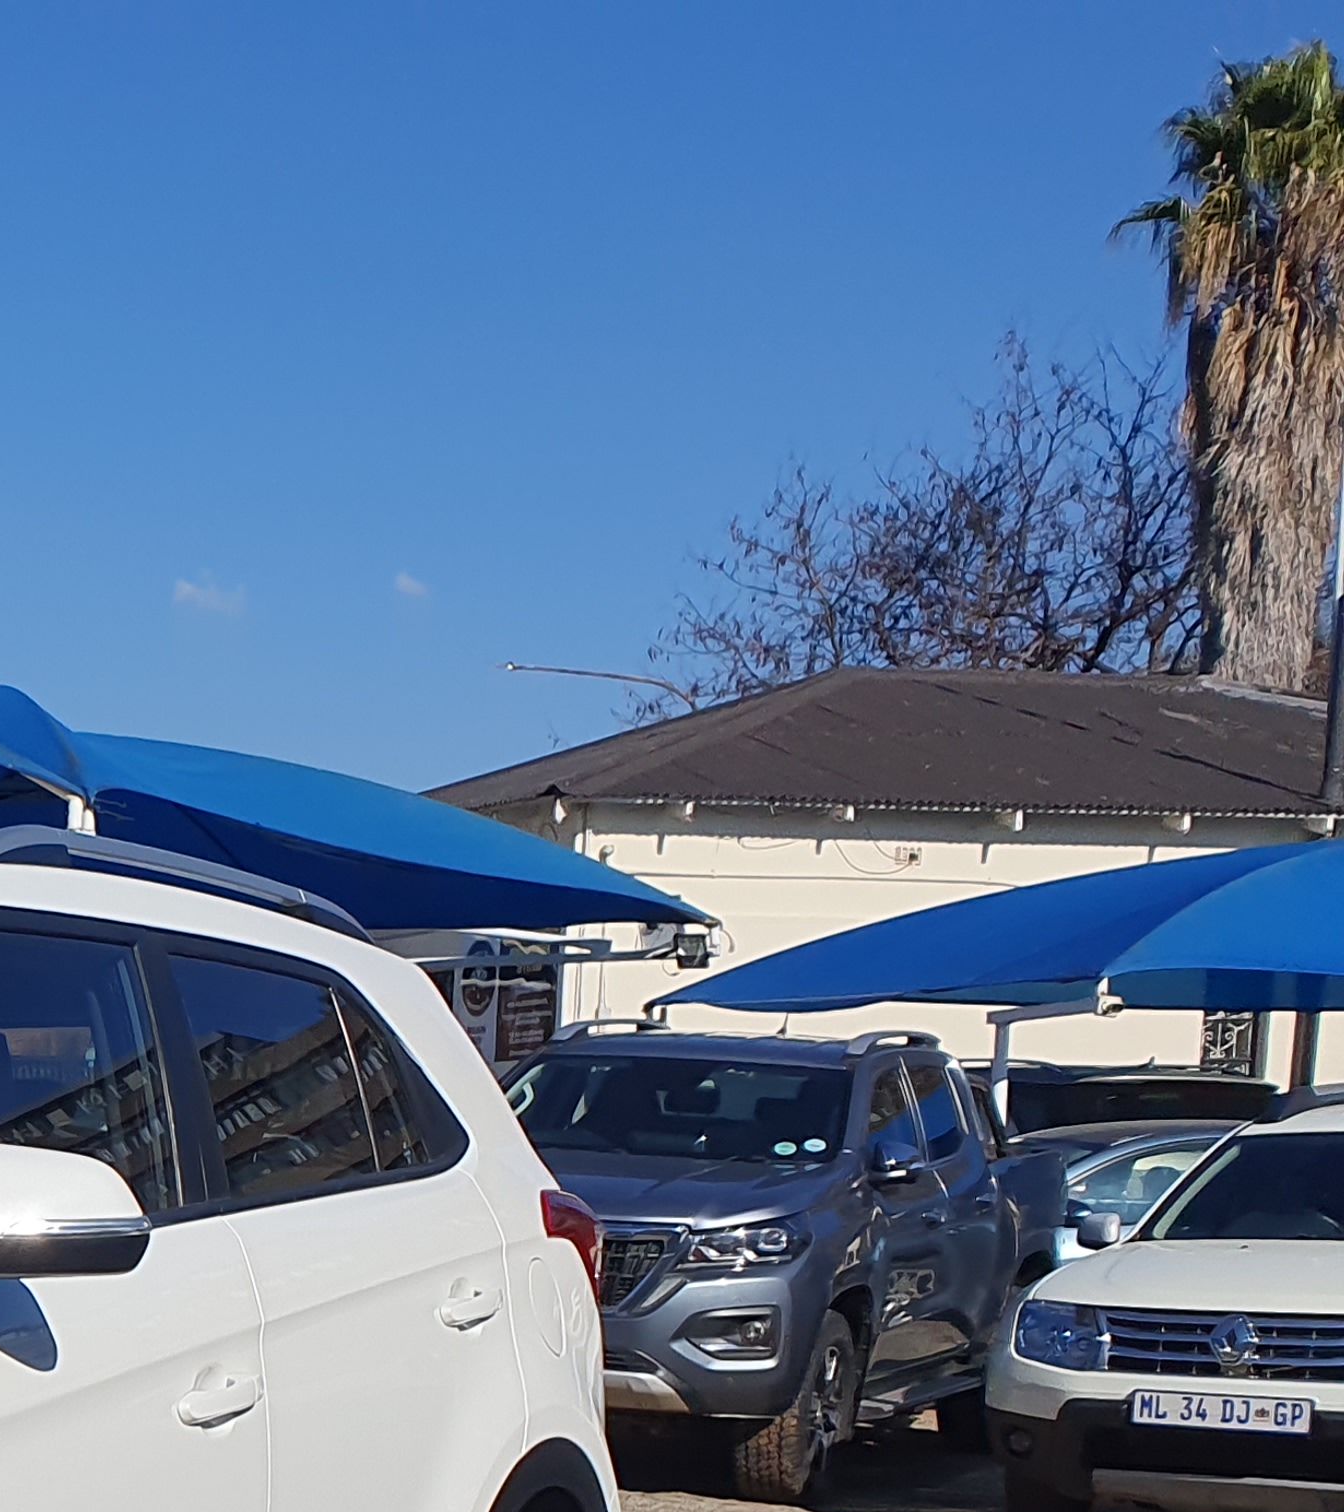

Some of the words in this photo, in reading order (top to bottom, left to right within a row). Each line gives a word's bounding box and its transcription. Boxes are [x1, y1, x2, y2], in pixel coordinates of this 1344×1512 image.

[1139, 1394, 1167, 1419] ML
[1180, 1396, 1207, 1421] 34
[1220, 1399, 1251, 1424] DJ
[1273, 1402, 1304, 1427] GP
